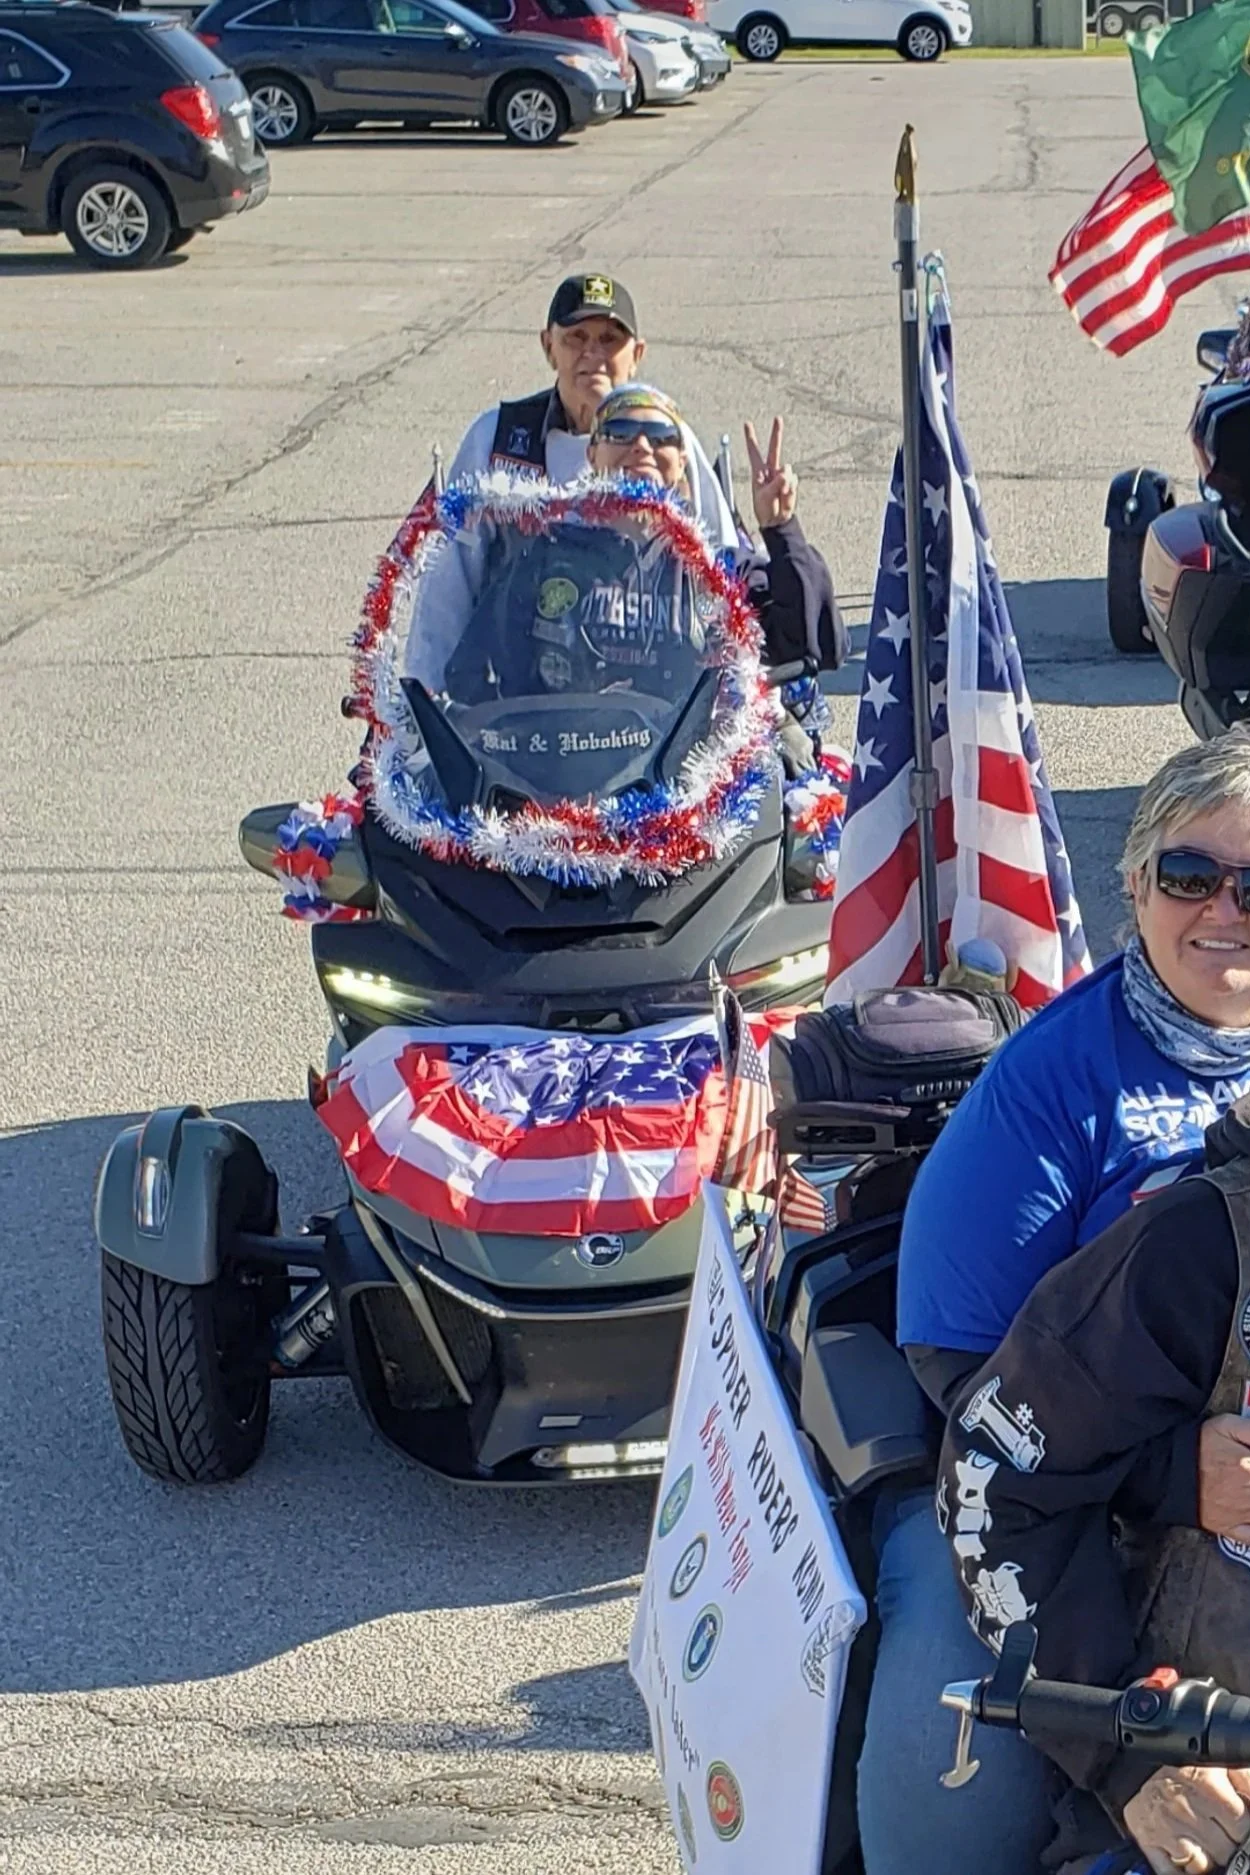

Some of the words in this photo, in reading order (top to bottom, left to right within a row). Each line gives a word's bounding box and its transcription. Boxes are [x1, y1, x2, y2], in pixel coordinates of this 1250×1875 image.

[529, 733, 549, 752] &
[711, 1311, 752, 1432] SPYDER
[747, 1430, 797, 1554] RYDERS
